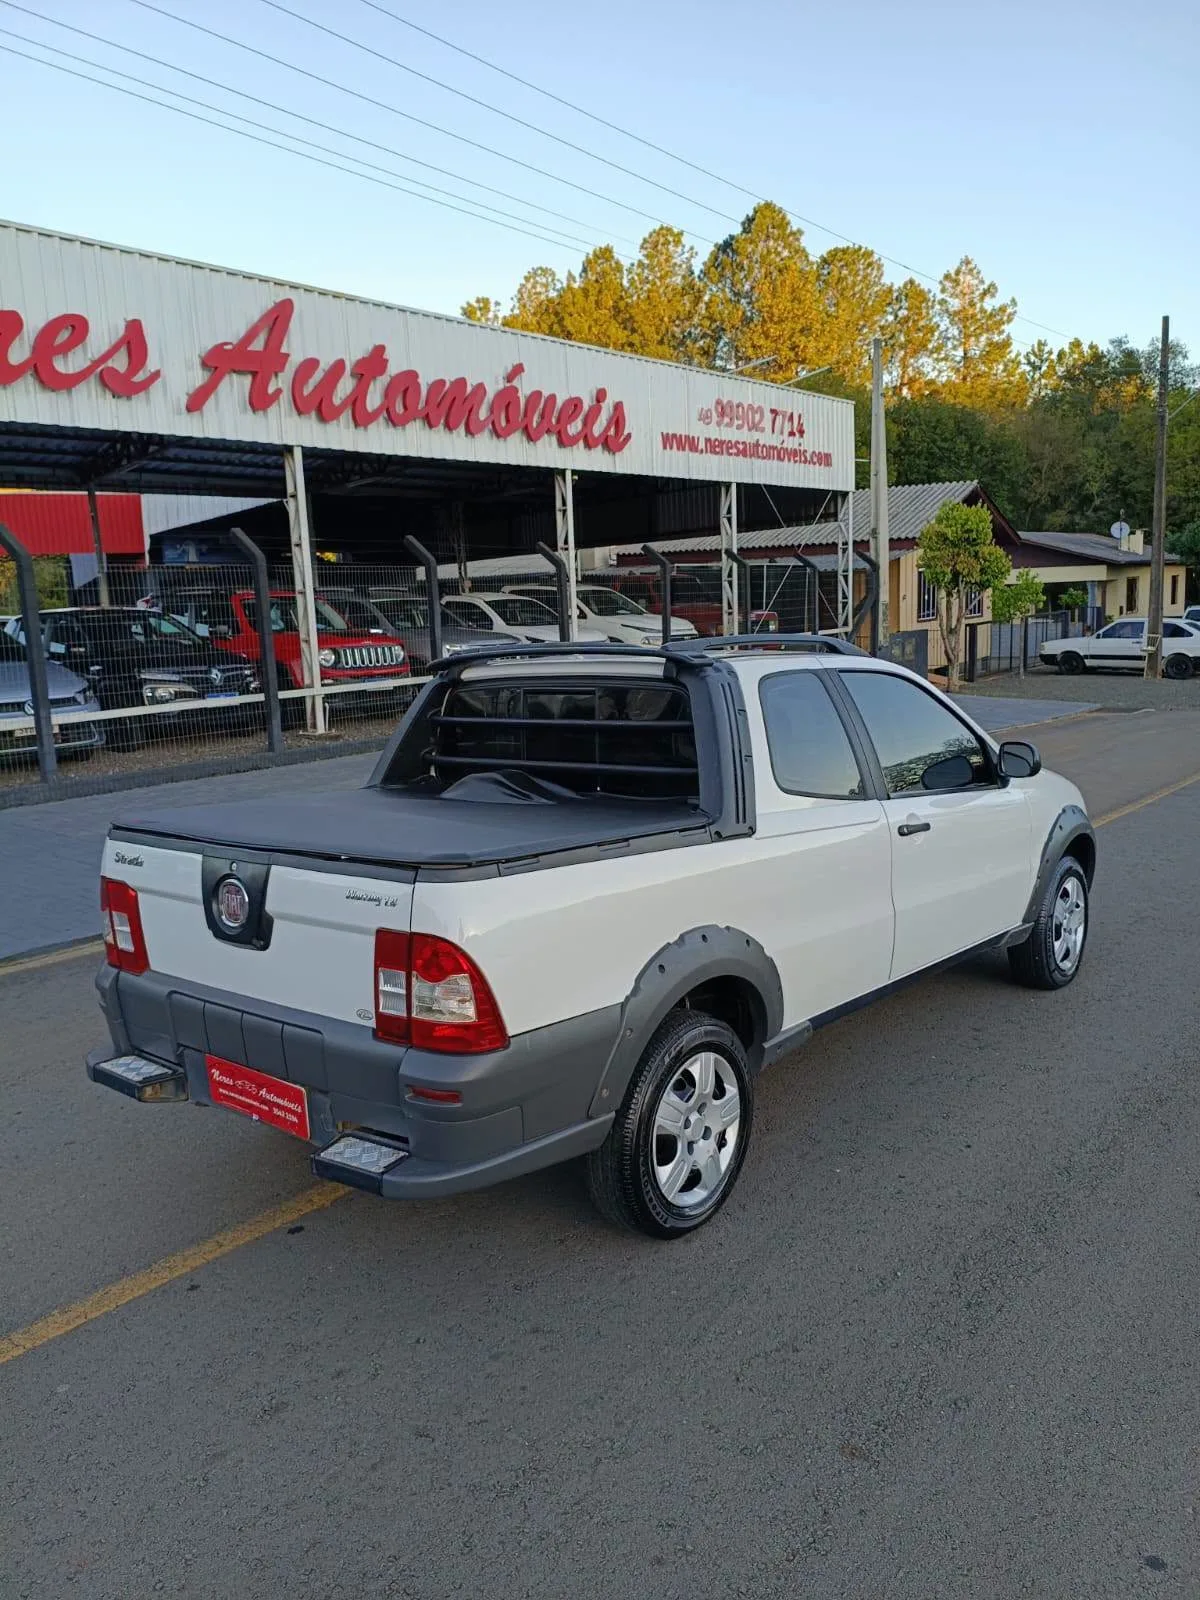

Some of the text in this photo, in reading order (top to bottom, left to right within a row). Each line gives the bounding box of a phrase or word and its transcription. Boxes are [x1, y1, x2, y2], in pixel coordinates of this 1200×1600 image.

[186, 298, 632, 453] Automóveis
[714, 397, 766, 433] 99902
[769, 407, 806, 439] 7714
[114, 851, 144, 868] Strada
[223, 893, 243, 915] FIAT
[211, 1068, 235, 1086] Neres
